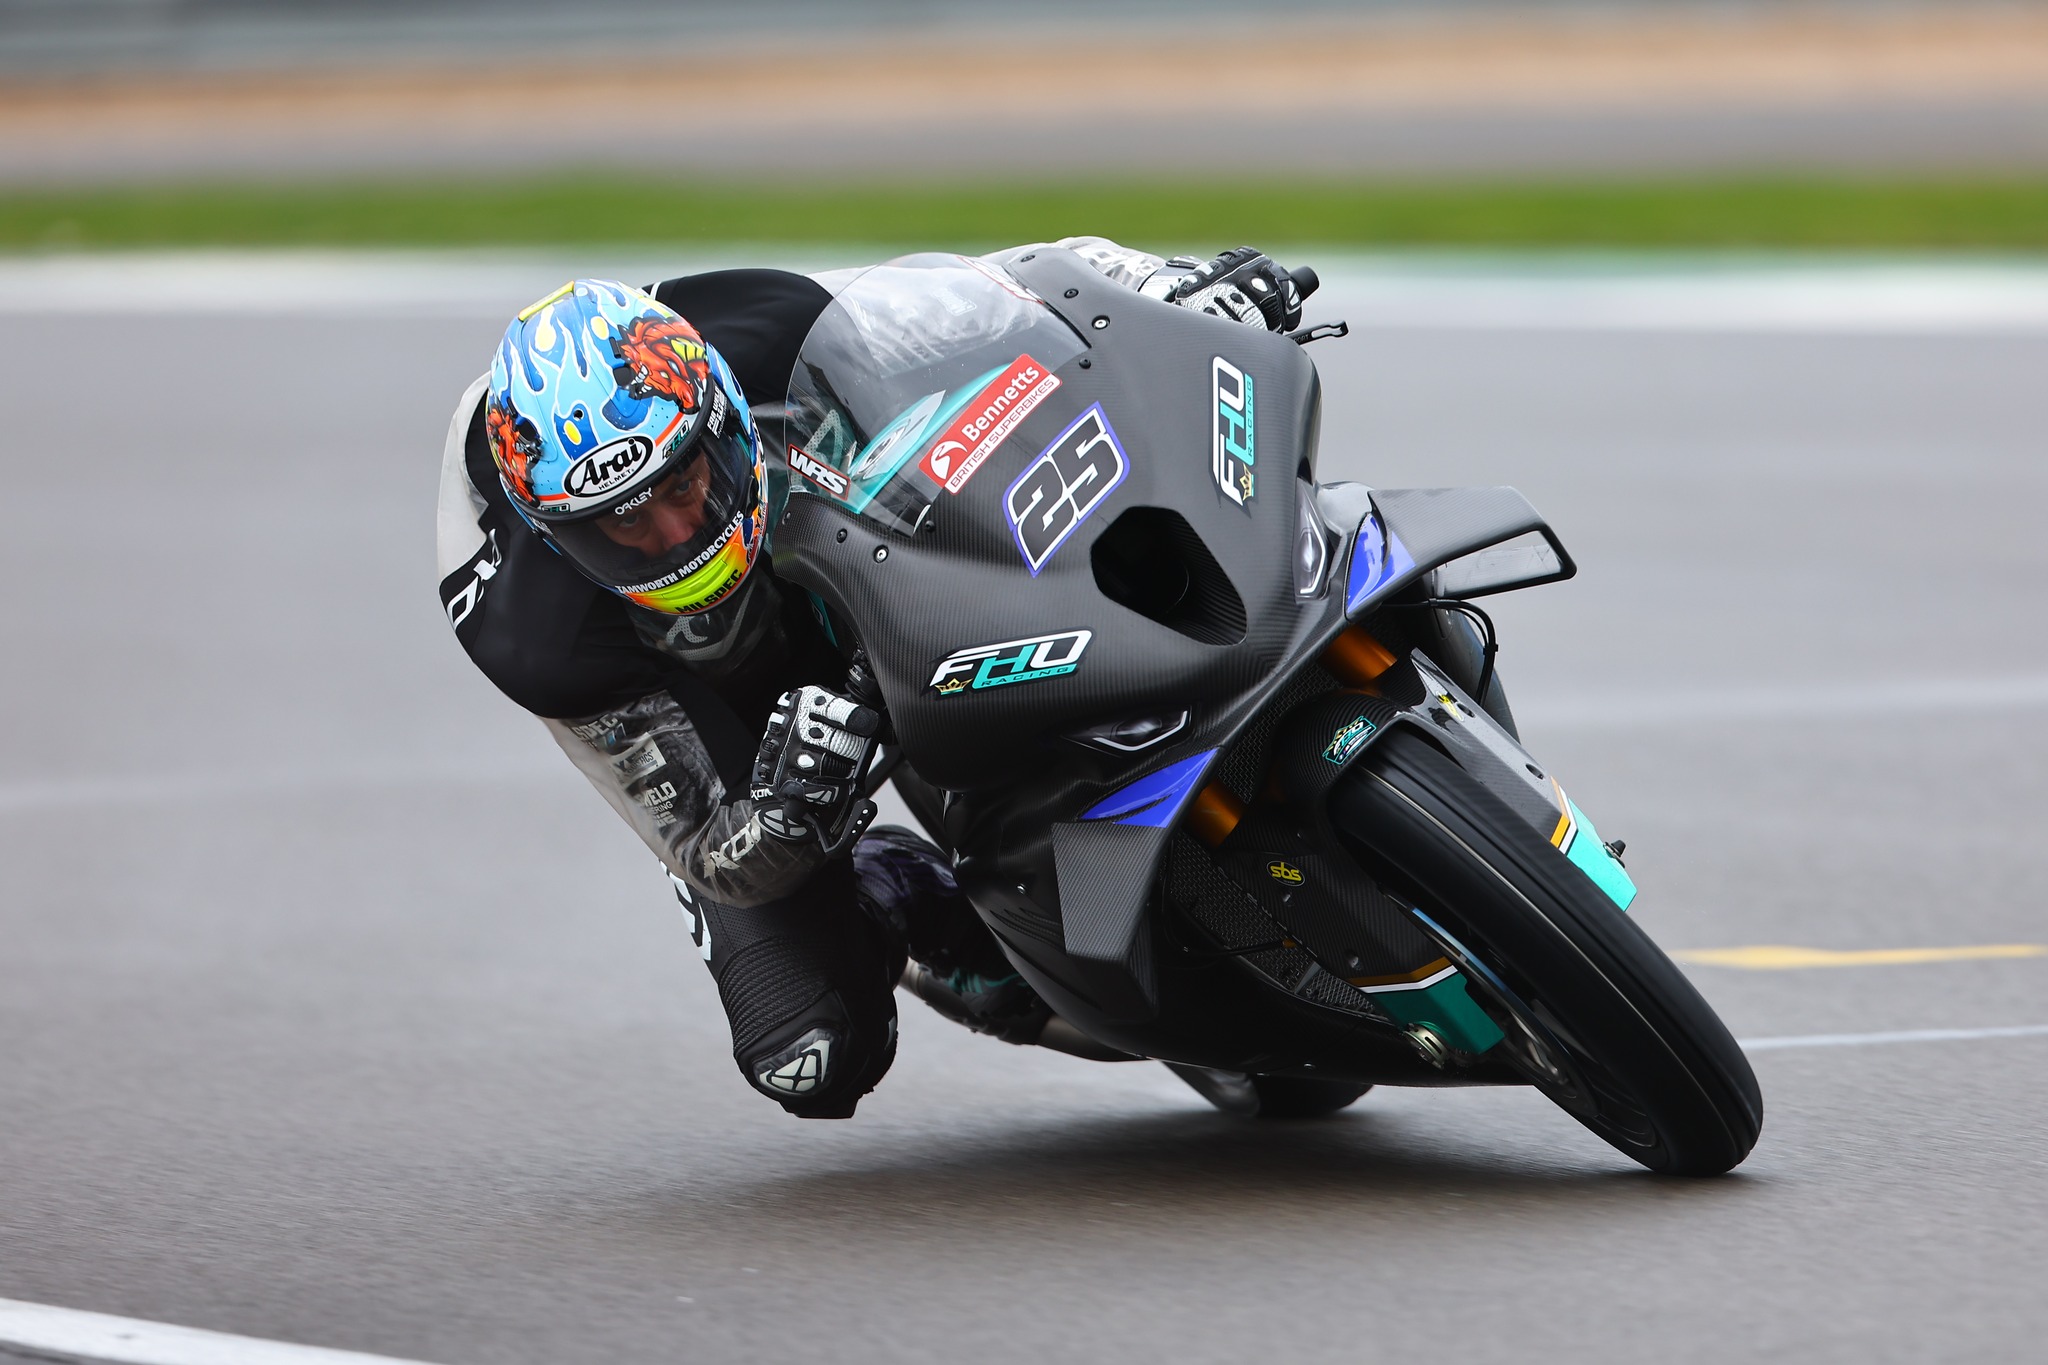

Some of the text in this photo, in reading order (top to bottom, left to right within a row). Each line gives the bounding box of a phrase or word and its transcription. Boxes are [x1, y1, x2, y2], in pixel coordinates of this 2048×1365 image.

[961, 366, 1040, 442] Bennetts
[1246, 380, 1254, 458] RACING
[950, 379, 1054, 488] BRITISH SUPERBIKES
[574, 437, 643, 495] Arai
[599, 469, 632, 490] HELMET
[790, 448, 848, 495] WRS
[1007, 407, 1125, 572] 25
[614, 487, 653, 515] OAKLEY
[615, 572, 679, 594] TAMWORTH
[677, 510, 744, 578] MOTORCYCLES
[675, 569, 743, 613] MILSPEC
[980, 667, 1069, 687] RACING
[1270, 862, 1302, 881] sbs
